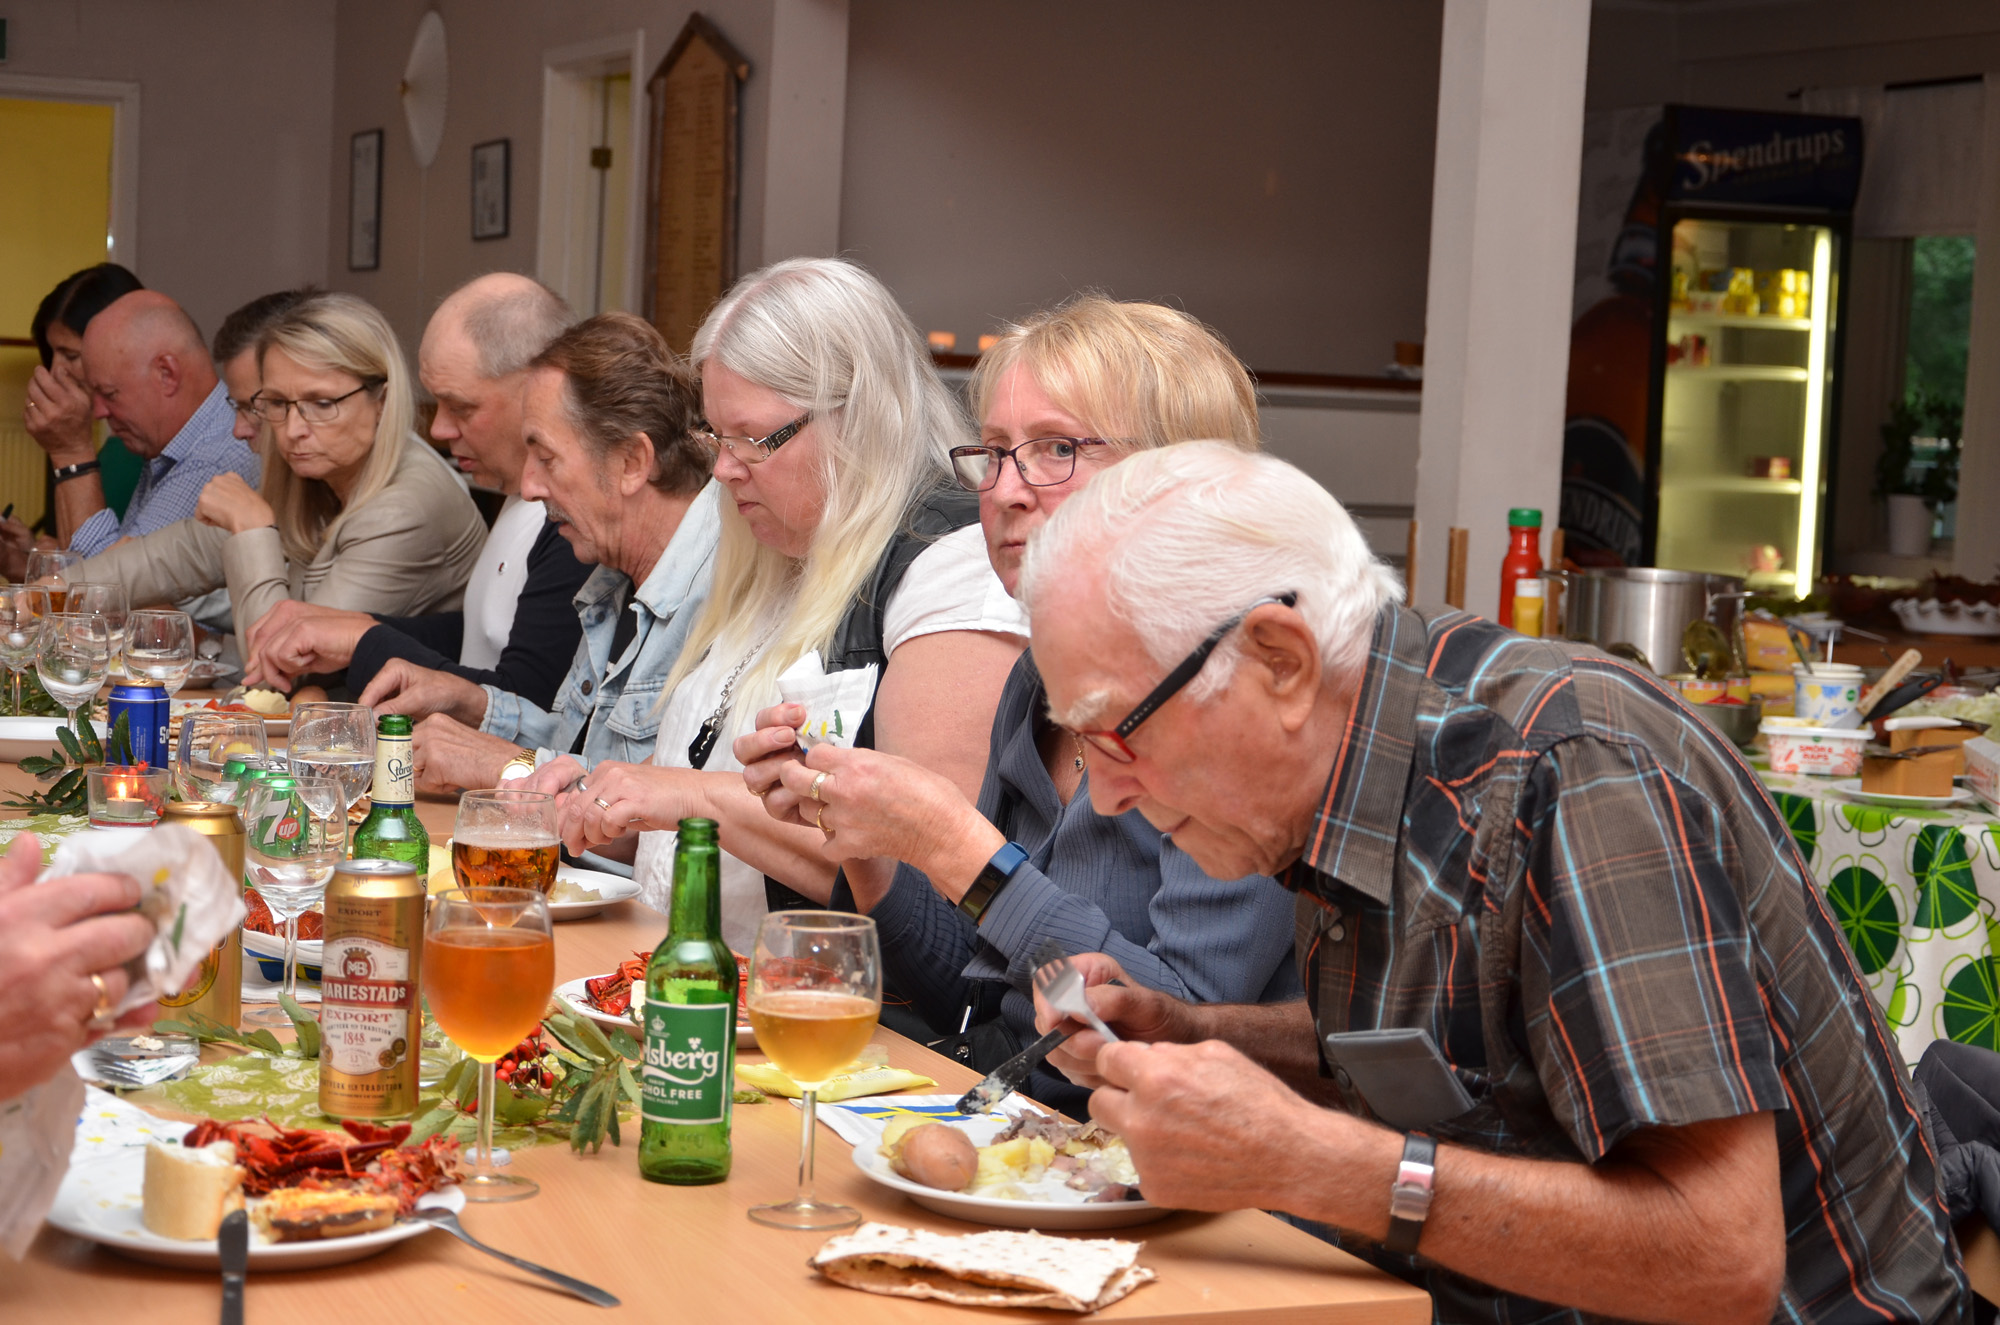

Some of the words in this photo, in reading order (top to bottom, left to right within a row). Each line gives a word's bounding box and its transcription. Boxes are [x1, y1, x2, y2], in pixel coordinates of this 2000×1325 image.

[1682, 129, 1845, 191] Spendrups
[337, 907, 382, 918] EXPORT
[326, 1009, 393, 1024] EXPORT
[360, 1023, 392, 1036] TRADITION
[643, 1035, 720, 1078] lsberg
[669, 1088, 703, 1100] FREE
